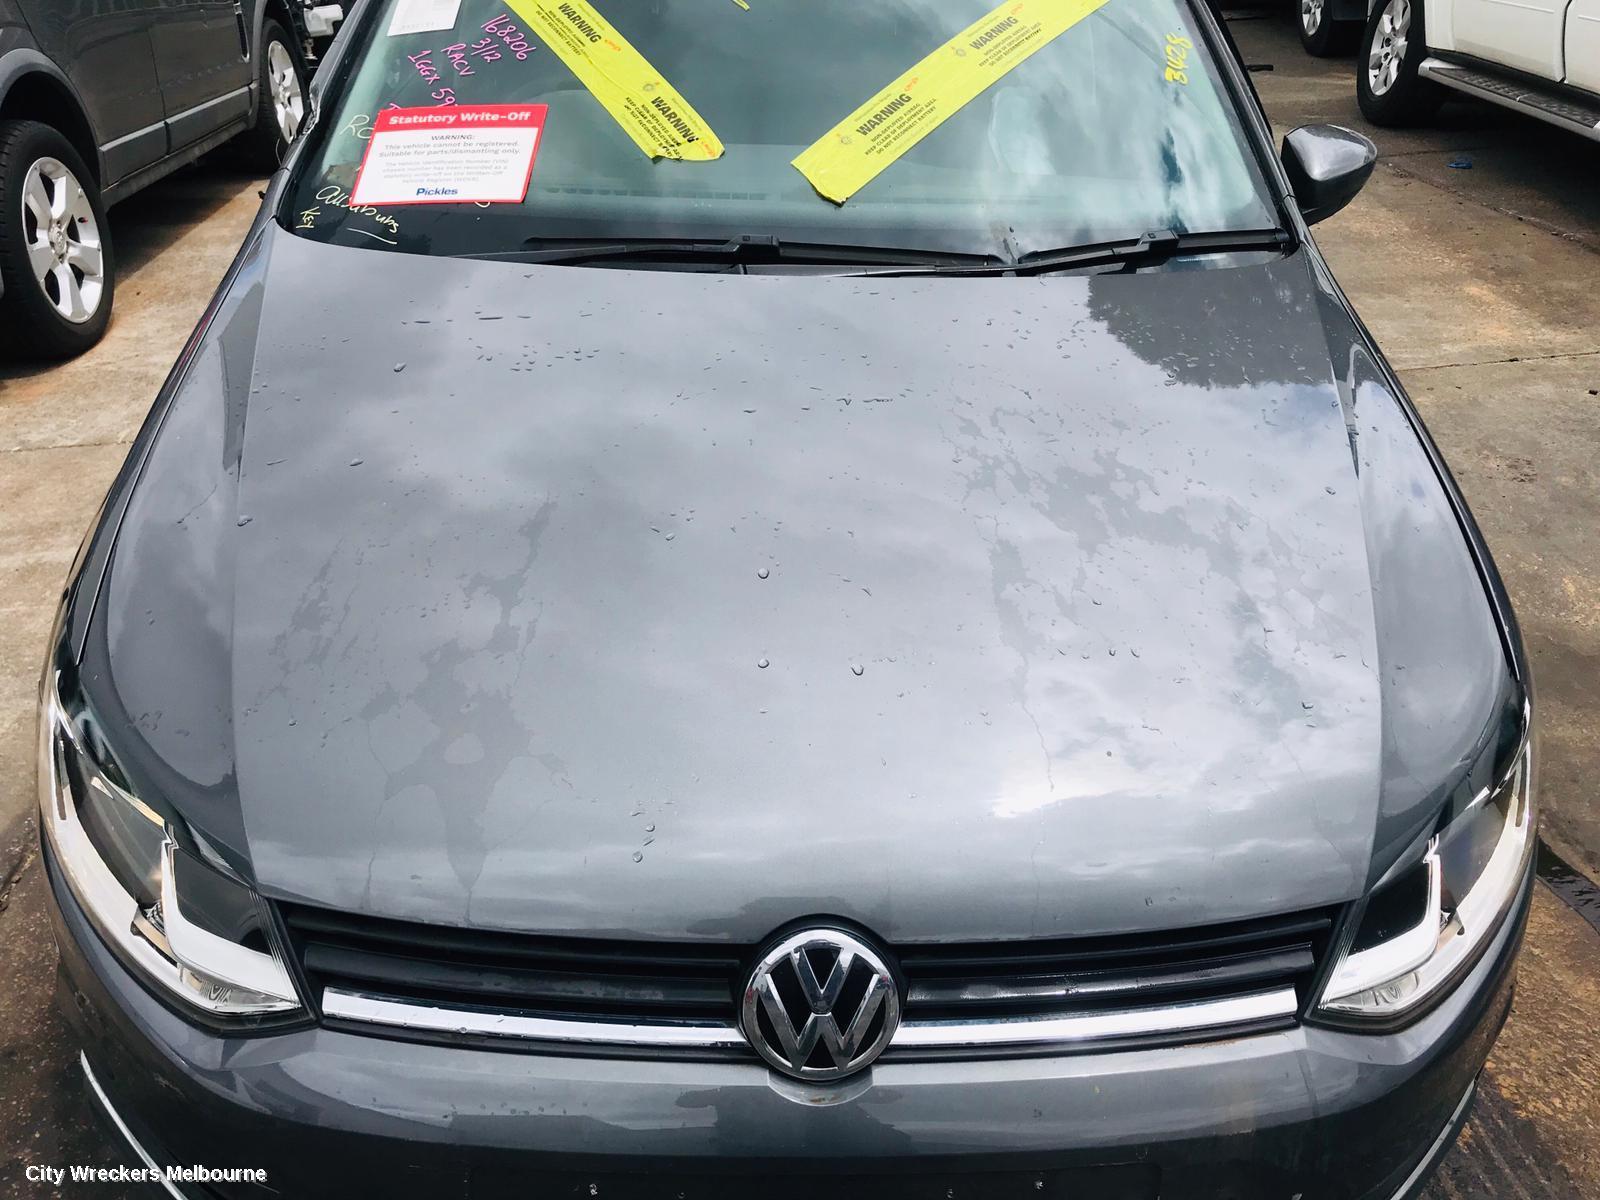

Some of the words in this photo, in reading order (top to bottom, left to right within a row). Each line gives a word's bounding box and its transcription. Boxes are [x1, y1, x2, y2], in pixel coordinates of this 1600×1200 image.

[558, 3, 602, 43] WARNING
[969, 16, 1018, 50] WARNING
[441, 43, 475, 76] RACV
[389, 114, 457, 125] Statutory
[460, 111, 531, 121] Write-Off
[651, 96, 699, 143] WARNING
[856, 93, 912, 136] WARNING
[416, 187, 458, 196] Pickles
